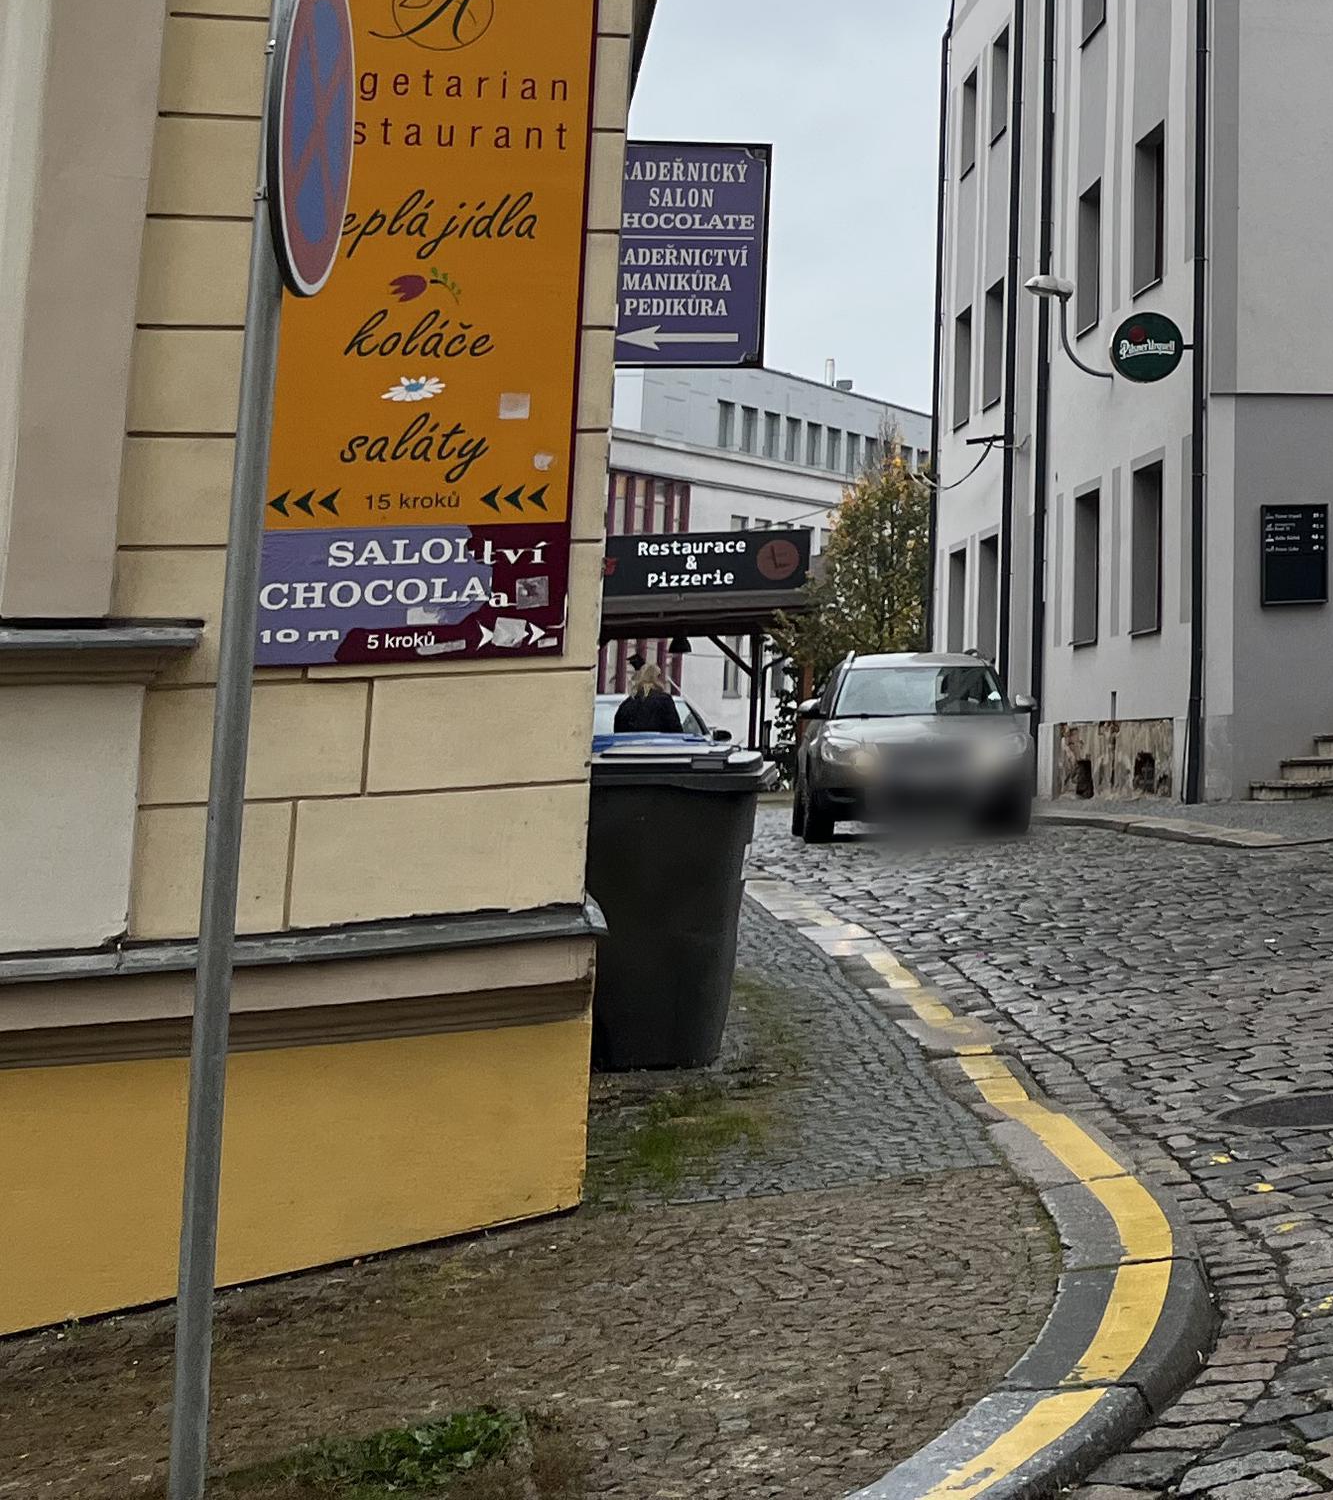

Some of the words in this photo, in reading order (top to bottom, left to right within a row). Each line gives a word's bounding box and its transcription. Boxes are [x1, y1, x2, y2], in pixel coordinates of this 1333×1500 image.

[359, 69, 569, 102] getarian
[354, 117, 568, 151] staurant
[648, 187, 715, 208] SALON
[341, 188, 435, 259] eplá
[415, 191, 539, 260] jídla
[621, 212, 756, 230] HOCOLATE
[620, 244, 749, 267] ADEŘNICTVÍ
[343, 308, 495, 358] koláče
[340, 411, 490, 484] saláty
[365, 493, 391, 511] 15
[399, 491, 461, 510] kroků
[477, 539, 550, 565] tví
[637, 540, 747, 556] Restaurace
[685, 555, 698, 570] &
[647, 569, 735, 588] Pizzerie
[258, 576, 492, 610] CHOCOLA
[259, 628, 300, 644] 10
[307, 628, 340, 642] m
[366, 634, 380, 650] 5
[384, 631, 436, 649] kroků
